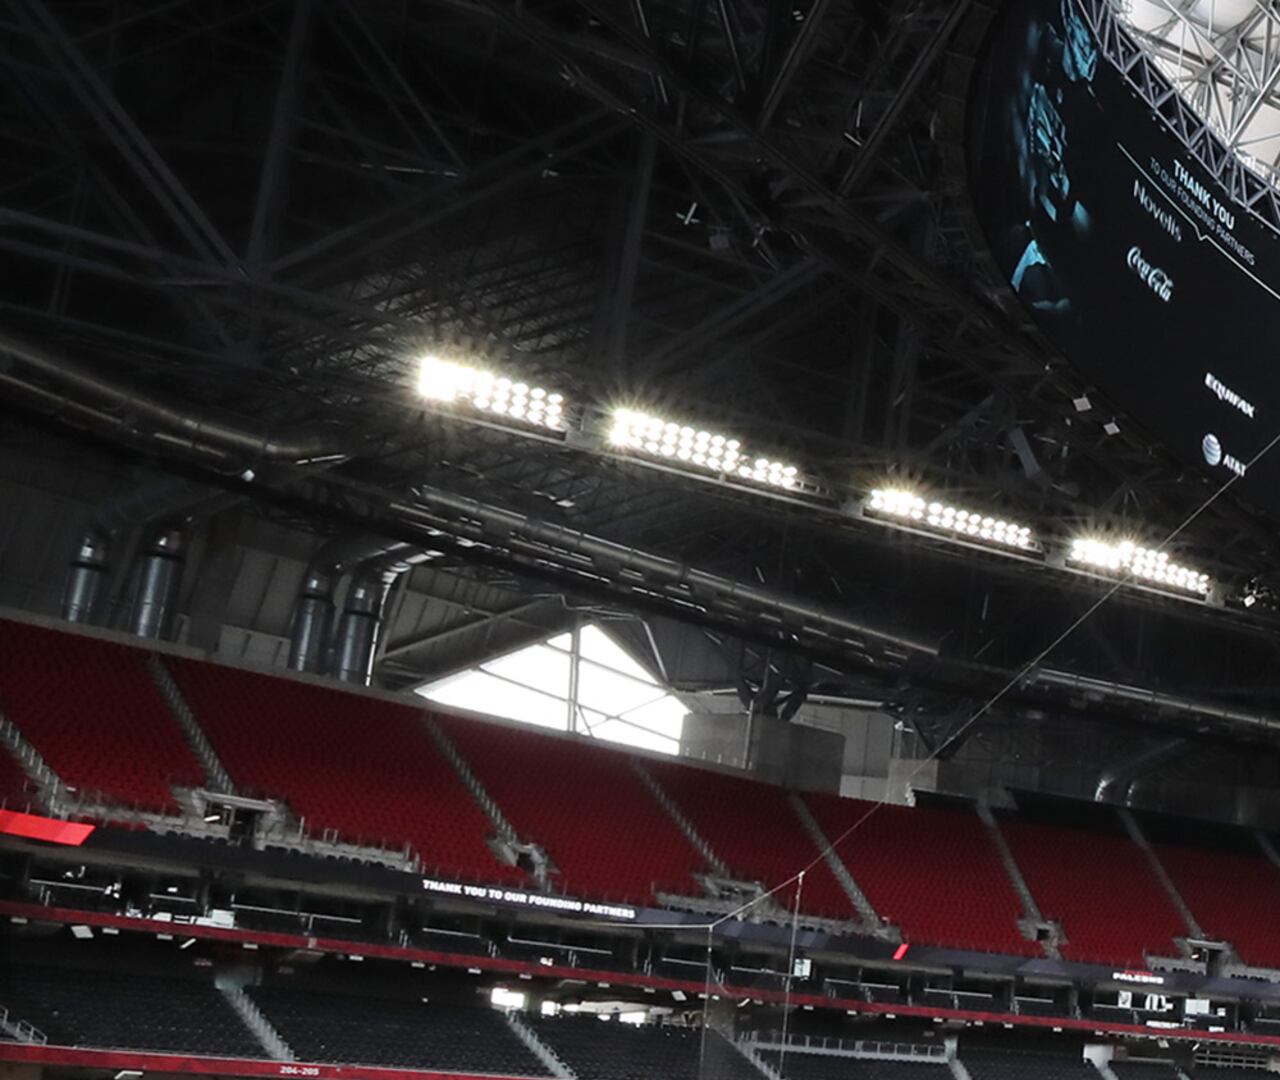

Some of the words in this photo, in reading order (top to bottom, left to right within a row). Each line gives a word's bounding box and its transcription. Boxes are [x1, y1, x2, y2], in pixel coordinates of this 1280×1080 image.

[1160, 171, 1177, 192] OUR
[1173, 159, 1210, 209] THANK
[1212, 199, 1235, 230] YOU
[1134, 179, 1182, 242] Novelis
[1204, 372, 1256, 418] EQUIFAX
[1222, 454, 1247, 477] AT&T
[423, 879, 462, 894] THANK
[464, 885, 487, 897] YOU
[489, 889, 503, 900] TO
[504, 891, 528, 904] OUR
[528, 896, 582, 911] FOUNDING
[583, 903, 635, 919] PARTNERS
